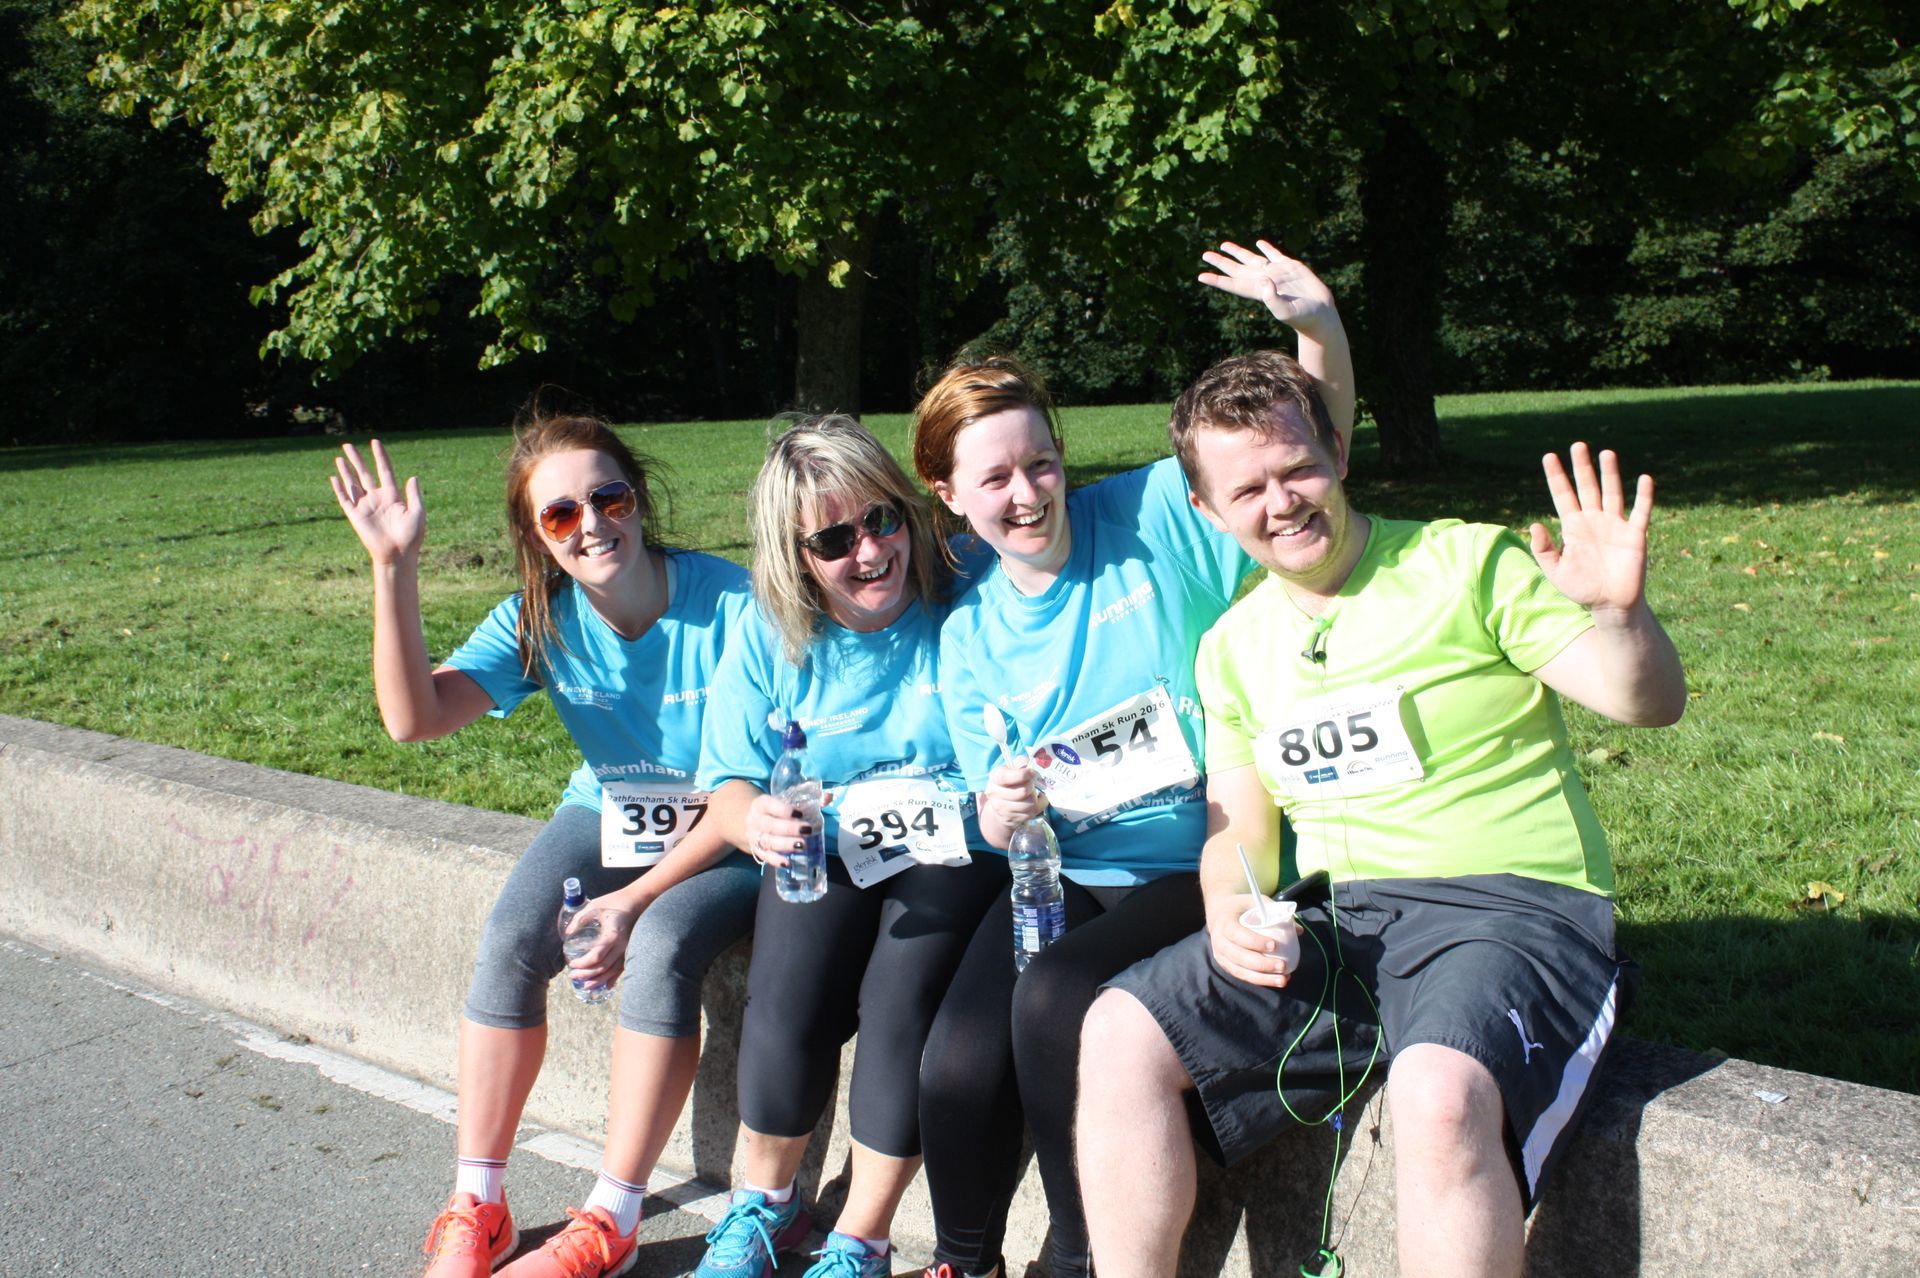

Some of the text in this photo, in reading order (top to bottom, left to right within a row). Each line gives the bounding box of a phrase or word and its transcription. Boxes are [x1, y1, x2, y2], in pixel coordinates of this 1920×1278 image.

[830, 707, 869, 723] IRELAND
[1102, 721, 1115, 731] 5k
[1117, 711, 1137, 725] Run
[1140, 700, 1166, 716] 2016
[1278, 711, 1379, 766] 805
[1054, 761, 1077, 780] BIO
[608, 794, 665, 803] Rathfarnham
[681, 796, 700, 804] Run
[907, 798, 927, 806] Run
[931, 800, 955, 811] 2016
[622, 803, 708, 836] 397
[852, 807, 939, 850] 394
